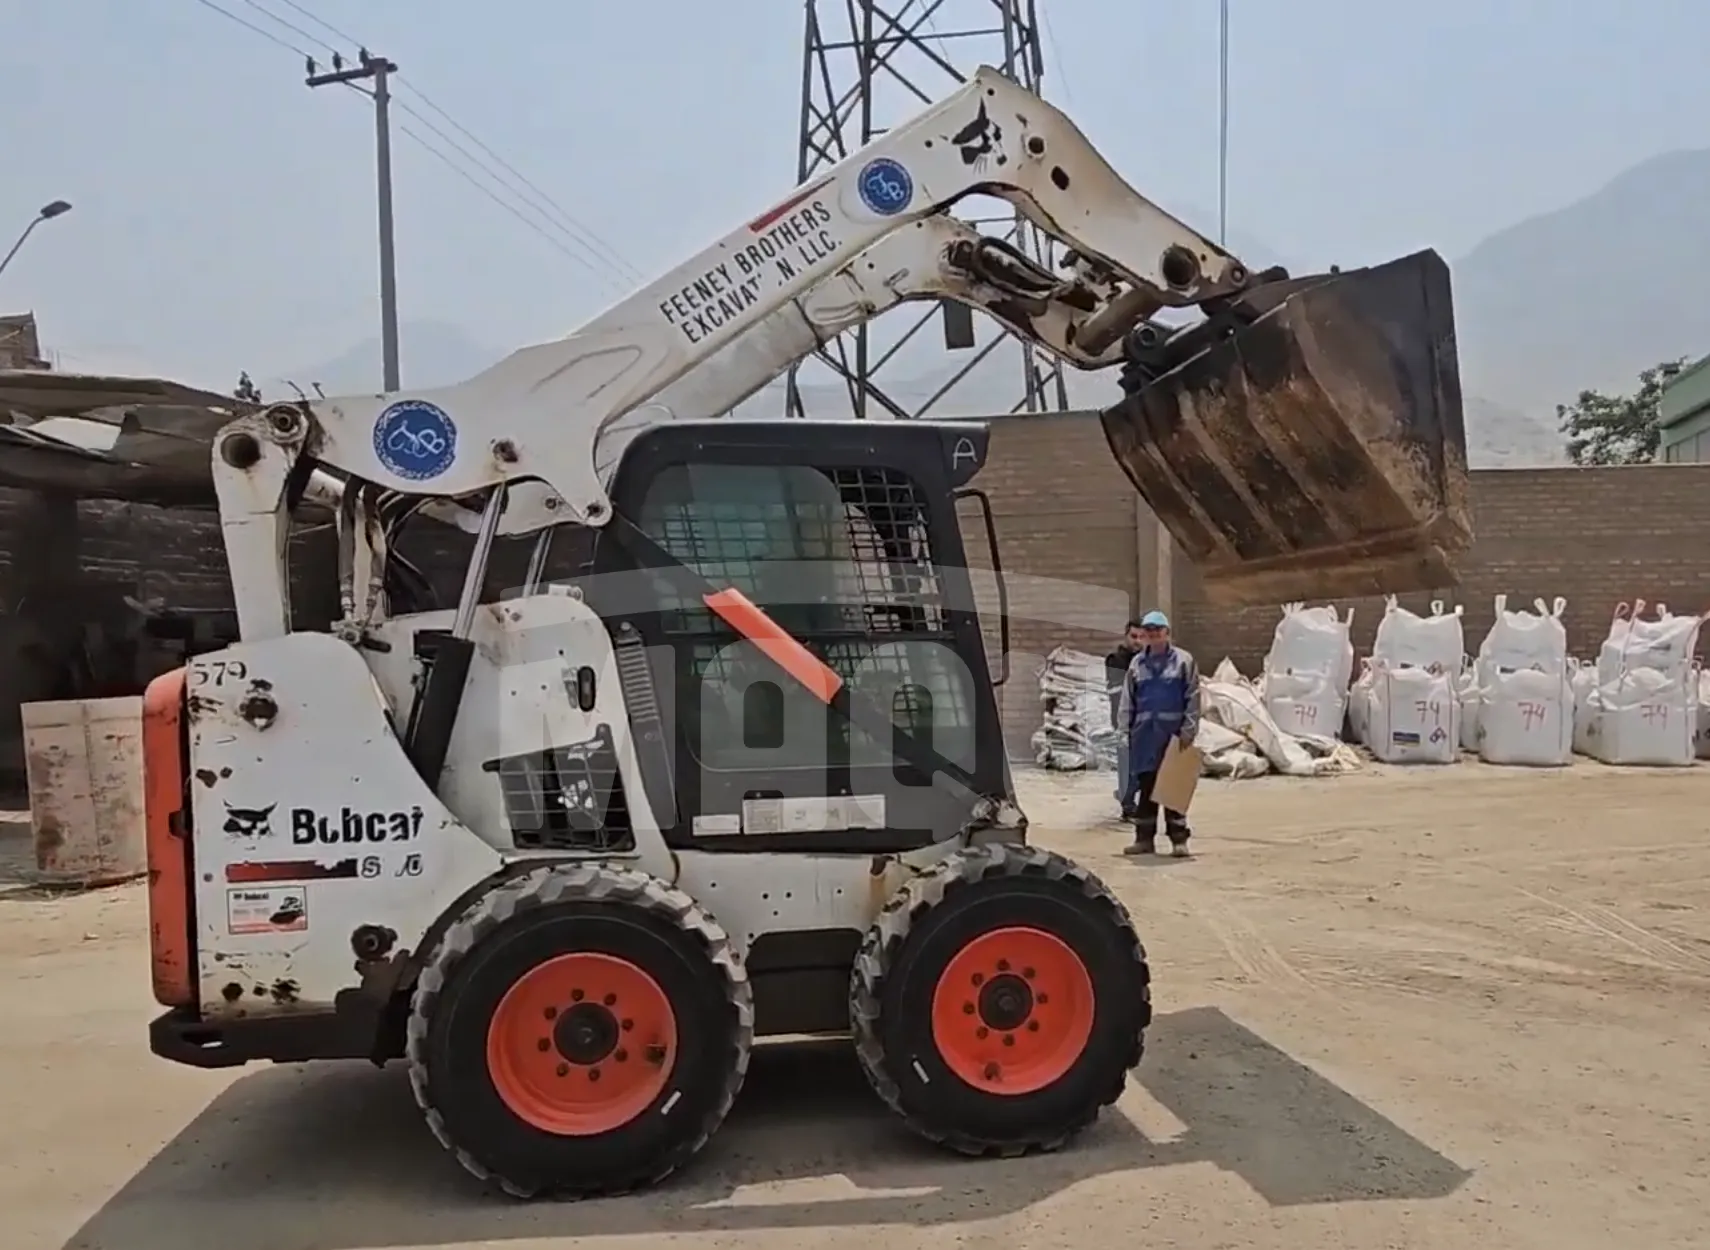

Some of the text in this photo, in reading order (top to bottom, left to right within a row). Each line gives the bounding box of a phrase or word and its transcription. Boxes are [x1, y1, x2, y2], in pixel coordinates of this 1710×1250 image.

[798, 230, 843, 266] LLC.
[659, 200, 832, 325] FEENEY BROTHERS
[952, 436, 978, 470] A
[193, 660, 247, 687] 579
[1294, 703, 1318, 726] 74
[1414, 700, 1441, 726] 74
[1517, 701, 1546, 731] 74
[1640, 703, 1669, 730] 74
